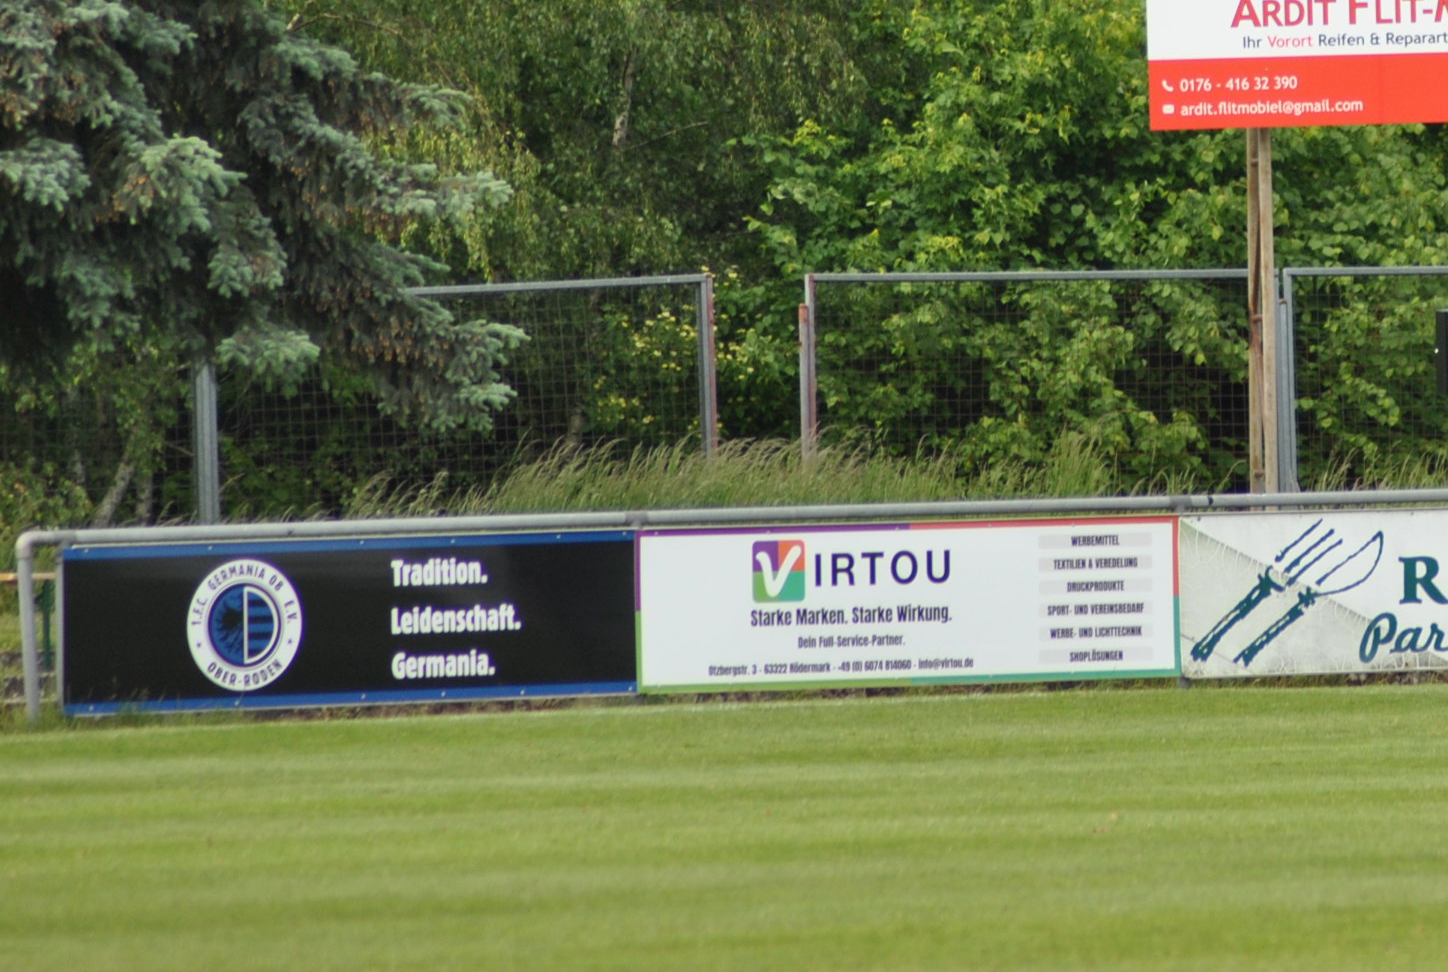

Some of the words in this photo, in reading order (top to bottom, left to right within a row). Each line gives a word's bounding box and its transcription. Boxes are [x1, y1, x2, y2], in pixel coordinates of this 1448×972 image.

[1243, 36, 1262, 49] Ihr
[1268, 35, 1313, 48] Vorort
[1318, 32, 1365, 47] Reifen
[1371, 33, 1380, 45] &
[1179, 78, 1212, 92] 0176
[1225, 77, 1250, 91] 416
[1254, 77, 1269, 90] 32
[1274, 76, 1298, 90] 390
[1180, 99, 1364, 116] ardit.flitmobiel@gmail.com
[1071, 535, 1119, 547] WERBEMITTEL
[391, 557, 488, 587] Tradition.
[1054, 559, 1086, 570] TEXTILIEN
[1095, 557, 1138, 569] VEREDELUNG
[207, 564, 265, 590] GERMANIA
[268, 574, 284, 591] 08
[1067, 580, 1124, 592] DRUCKPRODUKTE
[751, 609, 792, 627] Starke
[796, 608, 848, 626] Marken.
[852, 606, 893, 624] Starke
[897, 604, 952, 624] Wirkung.
[1048, 604, 1072, 616] SPORT-
[1074, 604, 1088, 615] UND
[1091, 603, 1144, 615] VEREINSBEDARF
[391, 603, 521, 635] Leidenschaft.
[1050, 628, 1077, 639] WERBE-
[1079, 627, 1093, 638] UND
[1095, 625, 1142, 638] LICHTTECHNIK
[798, 636, 816, 648] Dein
[819, 634, 906, 648] Full-Service-Partner.
[392, 649, 495, 679] Germania.
[1070, 649, 1123, 662] SHOPLÖSUNGEN
[207, 659, 282, 687] OBER-RODEN
[764, 663, 787, 674] 63322
[790, 661, 831, 674] Rödermark
[918, 657, 974, 670] info@virtou.de
